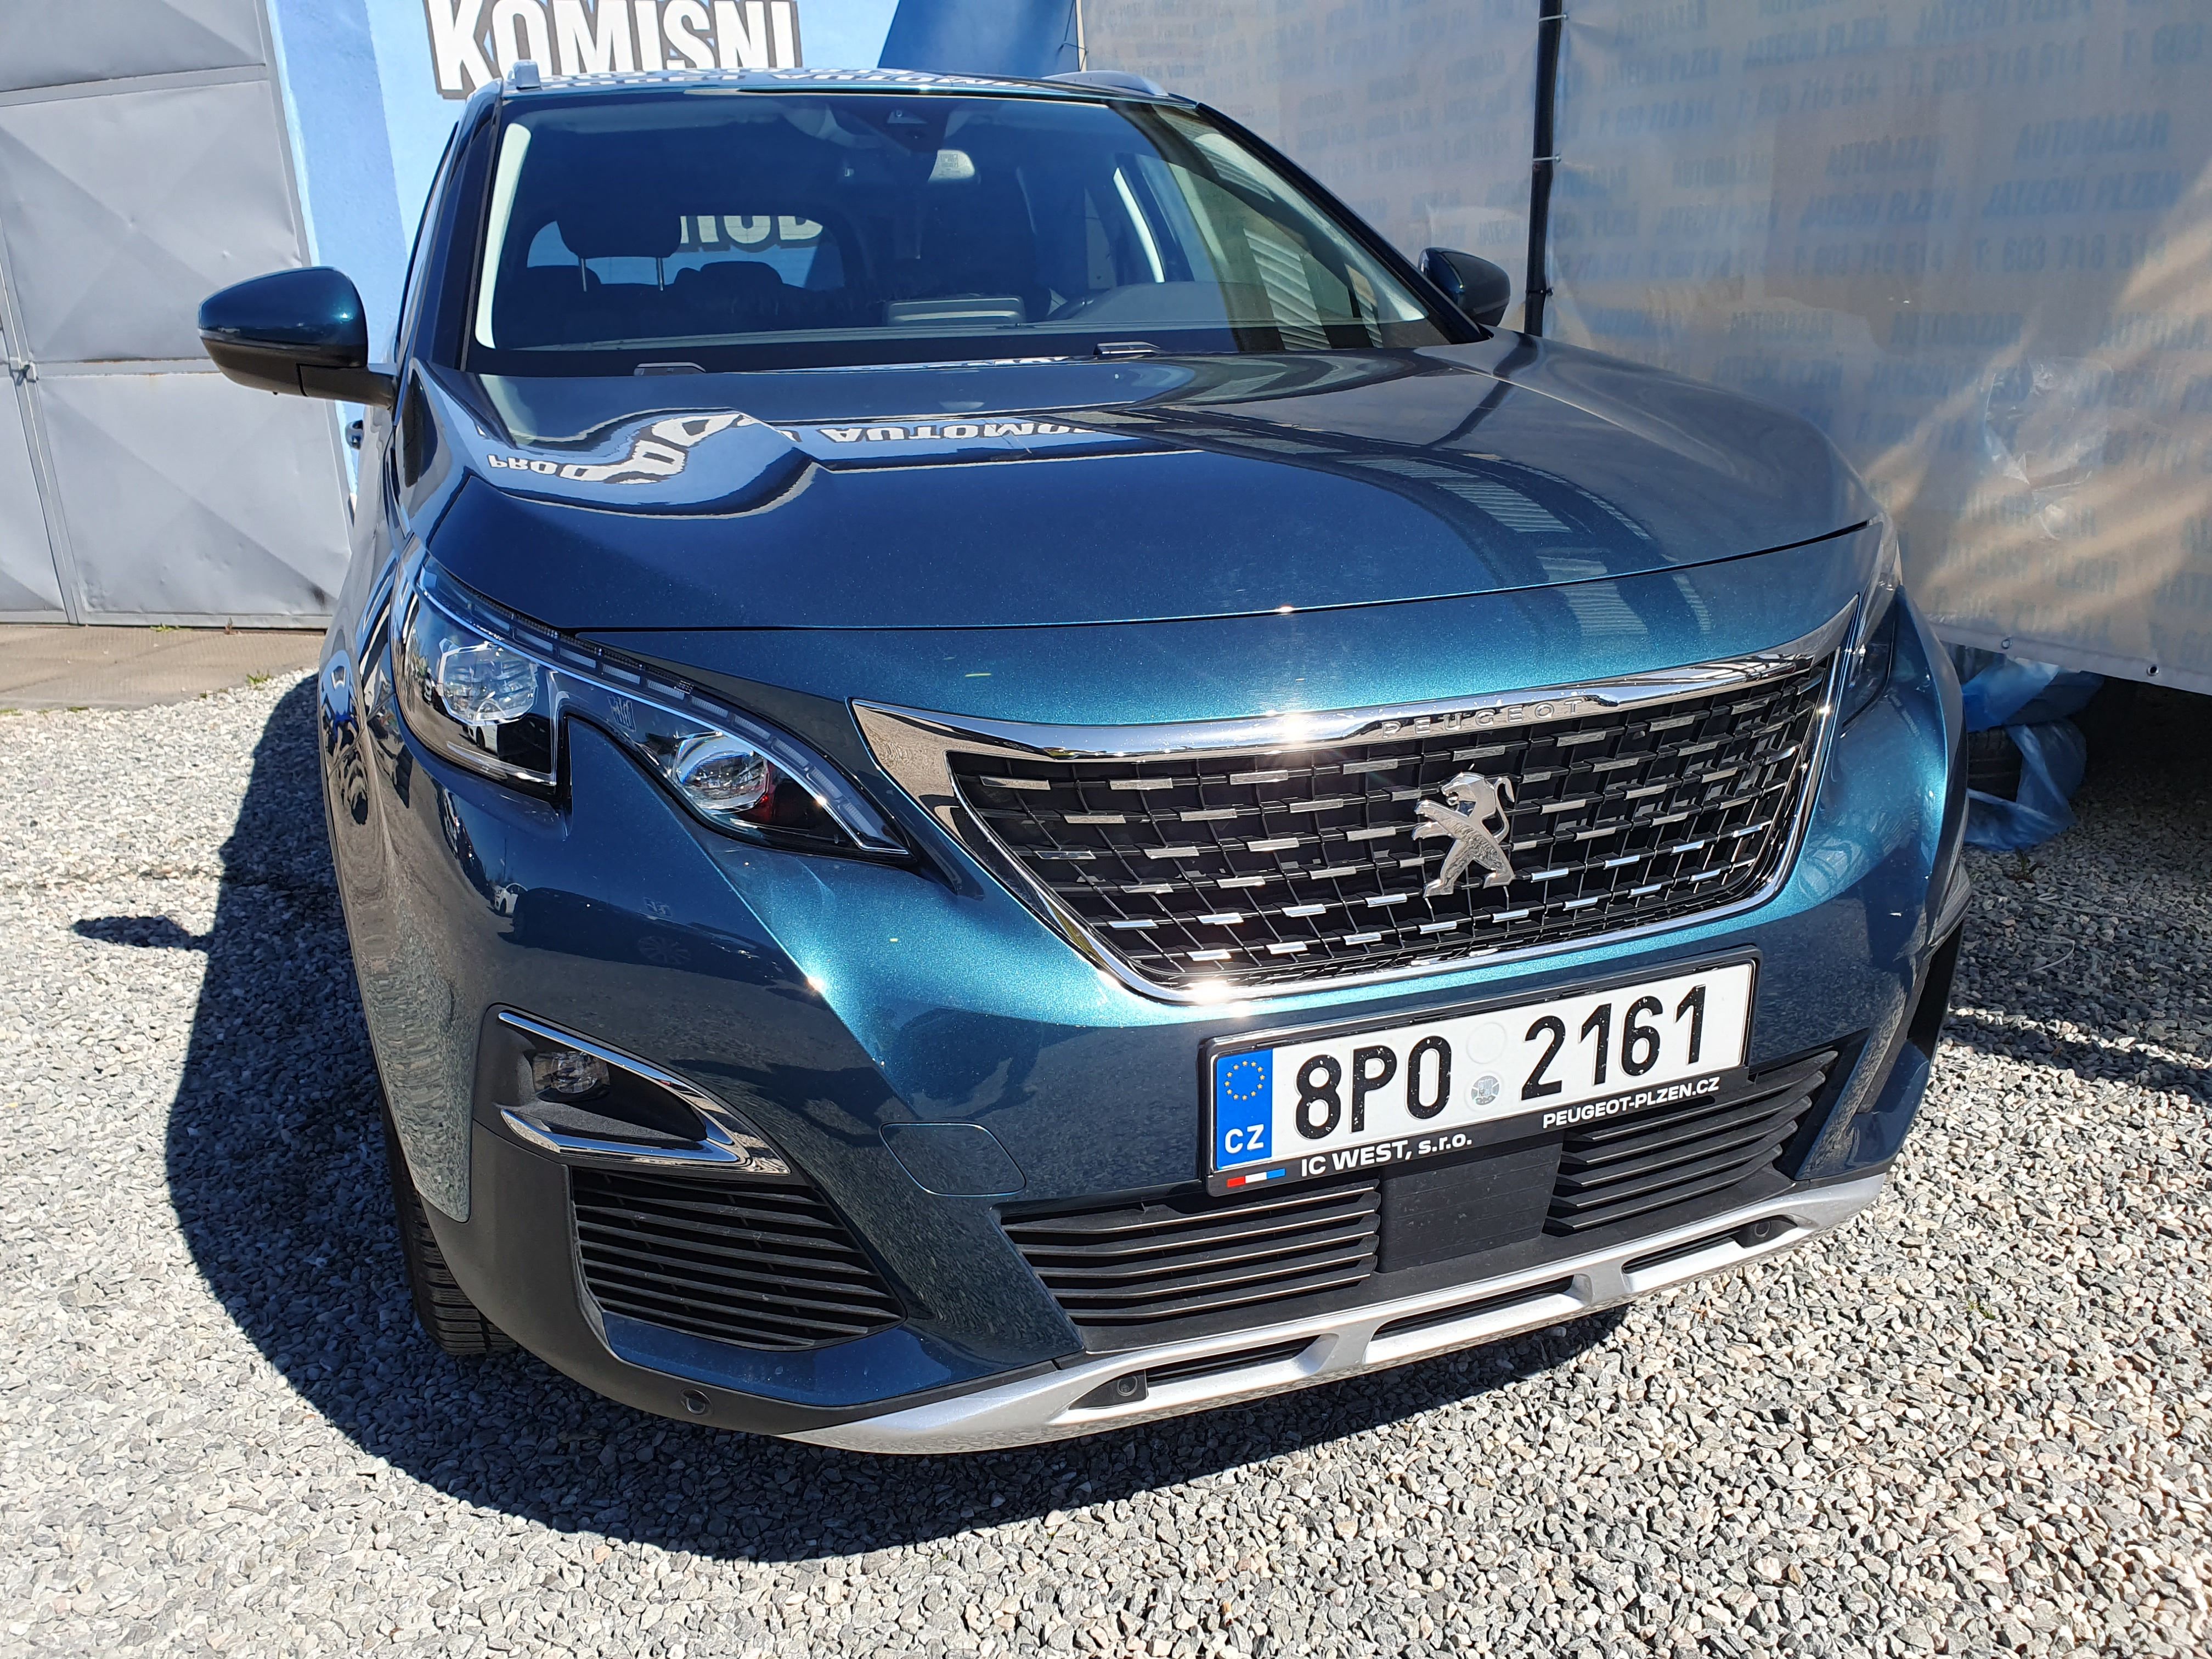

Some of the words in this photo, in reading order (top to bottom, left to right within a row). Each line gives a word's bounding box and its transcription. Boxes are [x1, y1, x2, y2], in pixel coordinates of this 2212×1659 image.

[1381, 699, 1583, 739] PEUGEOT
[1520, 984, 1707, 1102] 2161
[1542, 1076, 1721, 1129] PEUGEOT-PLZEN.CZ
[1224, 1123, 1265, 1154] CZ
[1301, 1155, 1327, 1177] IC
[1331, 1138, 1413, 1171] WEST,
[1417, 1132, 1473, 1155] s.r.o.
